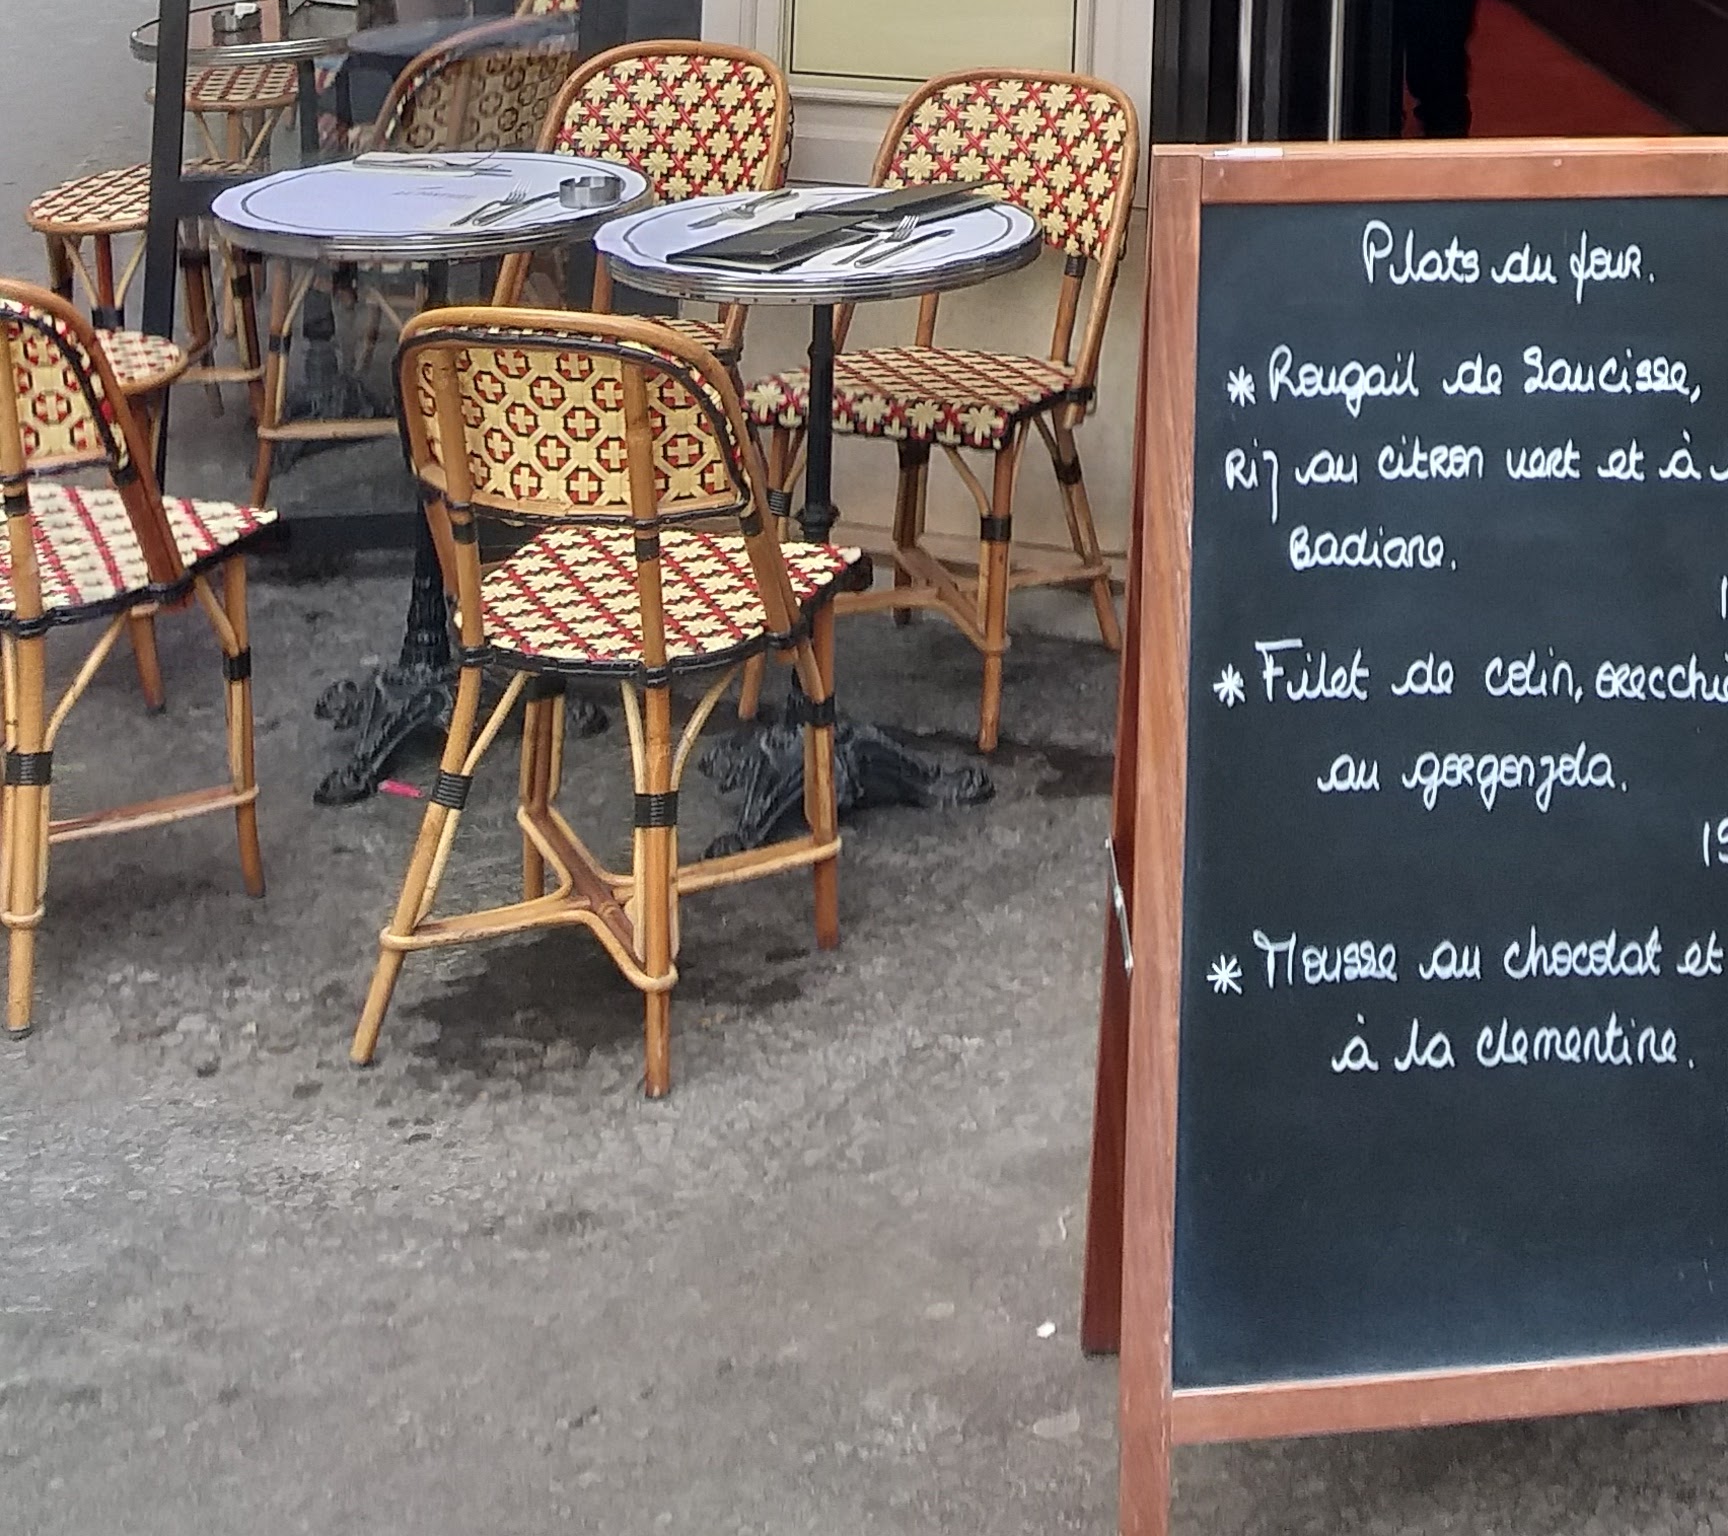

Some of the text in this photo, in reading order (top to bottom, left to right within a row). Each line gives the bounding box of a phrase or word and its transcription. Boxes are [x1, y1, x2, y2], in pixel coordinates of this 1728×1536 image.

[1363, 219, 1480, 285] Plats
[1491, 242, 1558, 284] du
[1268, 344, 1419, 418] Rougail
[1442, 352, 1503, 396] de
[1295, 449, 1358, 485] au
[1378, 434, 1484, 480] citron
[1506, 438, 1581, 480] vert
[1597, 438, 1645, 483] et
[1658, 428, 1702, 480] à
[1254, 638, 1370, 702] Filet
[1391, 651, 1454, 696] de
[1317, 740, 1627, 813] au gorgonzola.
[1253, 924, 1724, 989] Mousse au chocolat et
[1331, 1012, 1379, 1073] à
[1395, 1017, 1456, 1072] la
